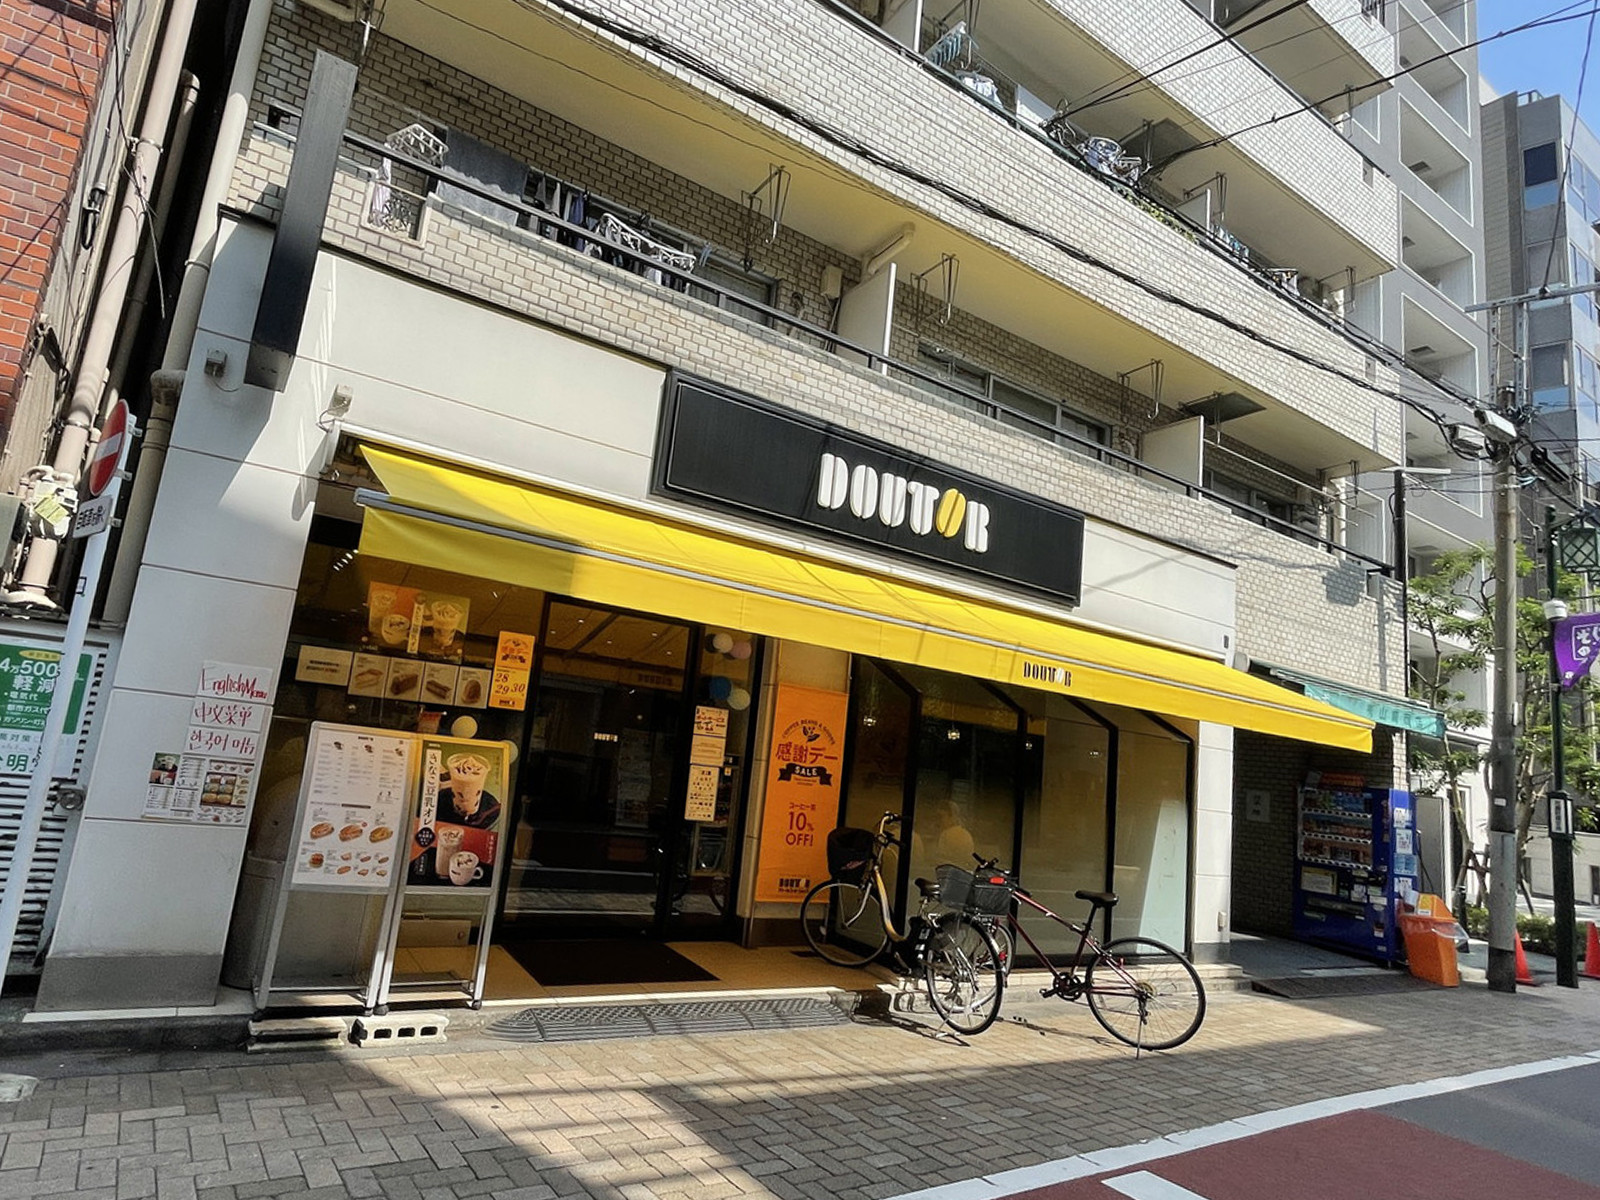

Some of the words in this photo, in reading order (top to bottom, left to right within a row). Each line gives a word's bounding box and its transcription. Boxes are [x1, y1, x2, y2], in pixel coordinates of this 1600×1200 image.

[817, 453, 990, 553] DOUTOR
[1024, 661, 1072, 687] DOUTOR
[776, 741, 838, 764] 感謝デー
[0, 754, 29, 772] 明
[794, 765, 818, 777] SALE
[785, 832, 814, 847] OFF!
